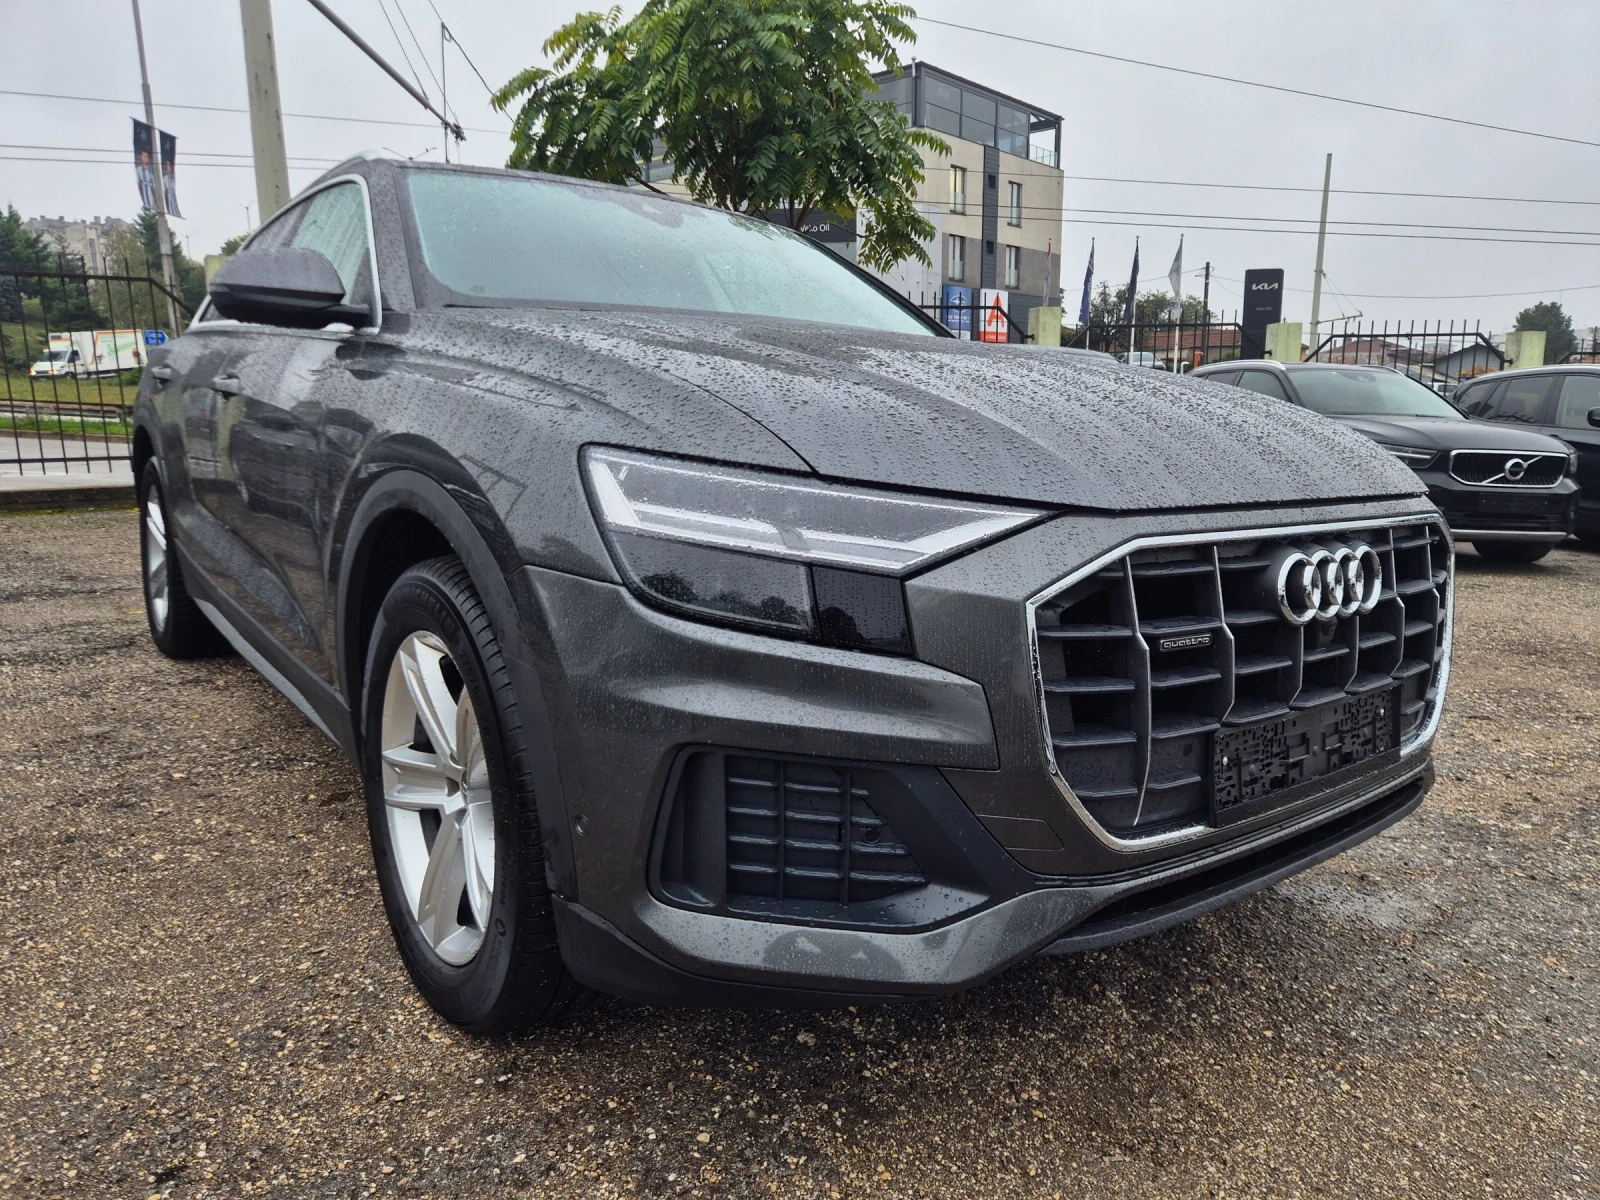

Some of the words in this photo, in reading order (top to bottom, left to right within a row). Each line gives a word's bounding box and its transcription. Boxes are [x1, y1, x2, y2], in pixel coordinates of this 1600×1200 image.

[820, 223, 830, 232] Oil
[1252, 282, 1279, 290] KIA
[1163, 637, 1210, 649] quattro
